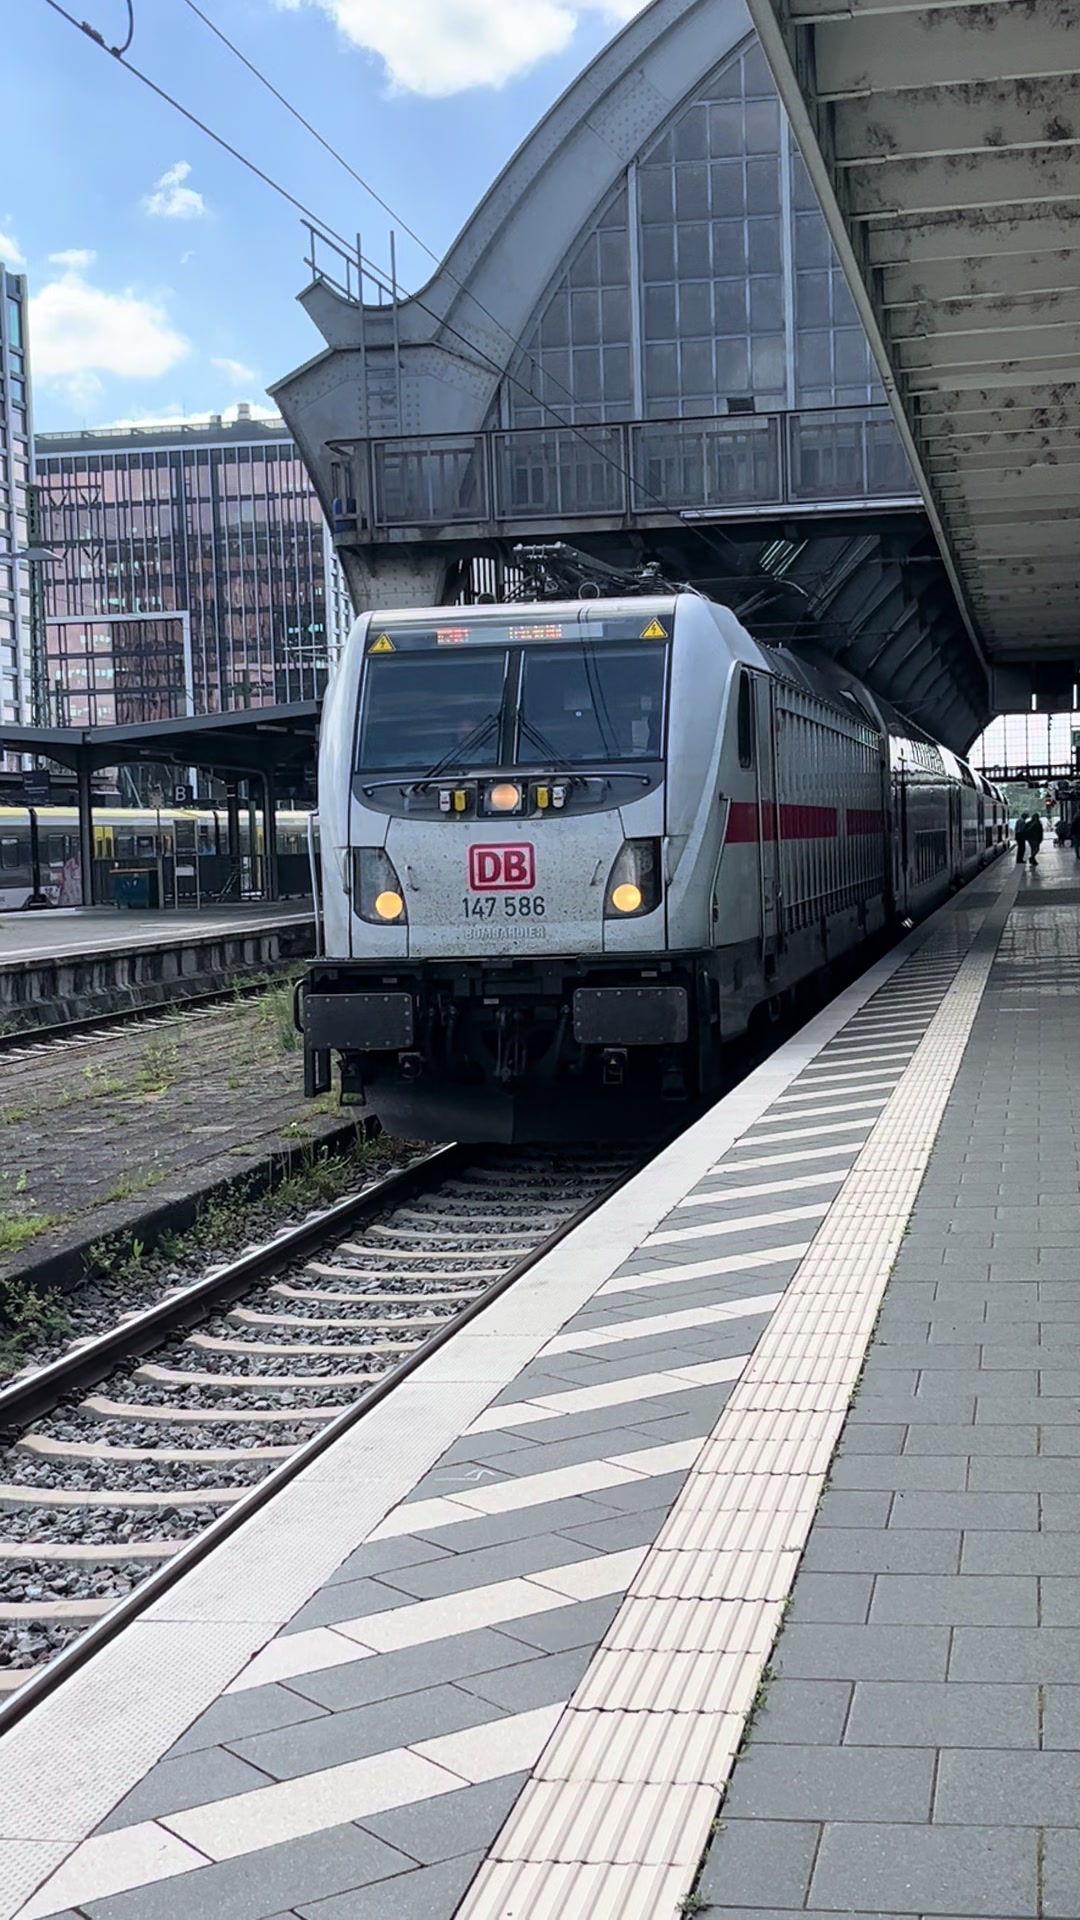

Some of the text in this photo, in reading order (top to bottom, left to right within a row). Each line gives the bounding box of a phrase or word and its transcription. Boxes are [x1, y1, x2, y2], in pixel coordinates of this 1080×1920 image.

[175, 786, 187, 802] B
[477, 850, 528, 884] DB
[462, 896, 546, 918] 147 586
[464, 925, 546, 940] BOMBARDIER
